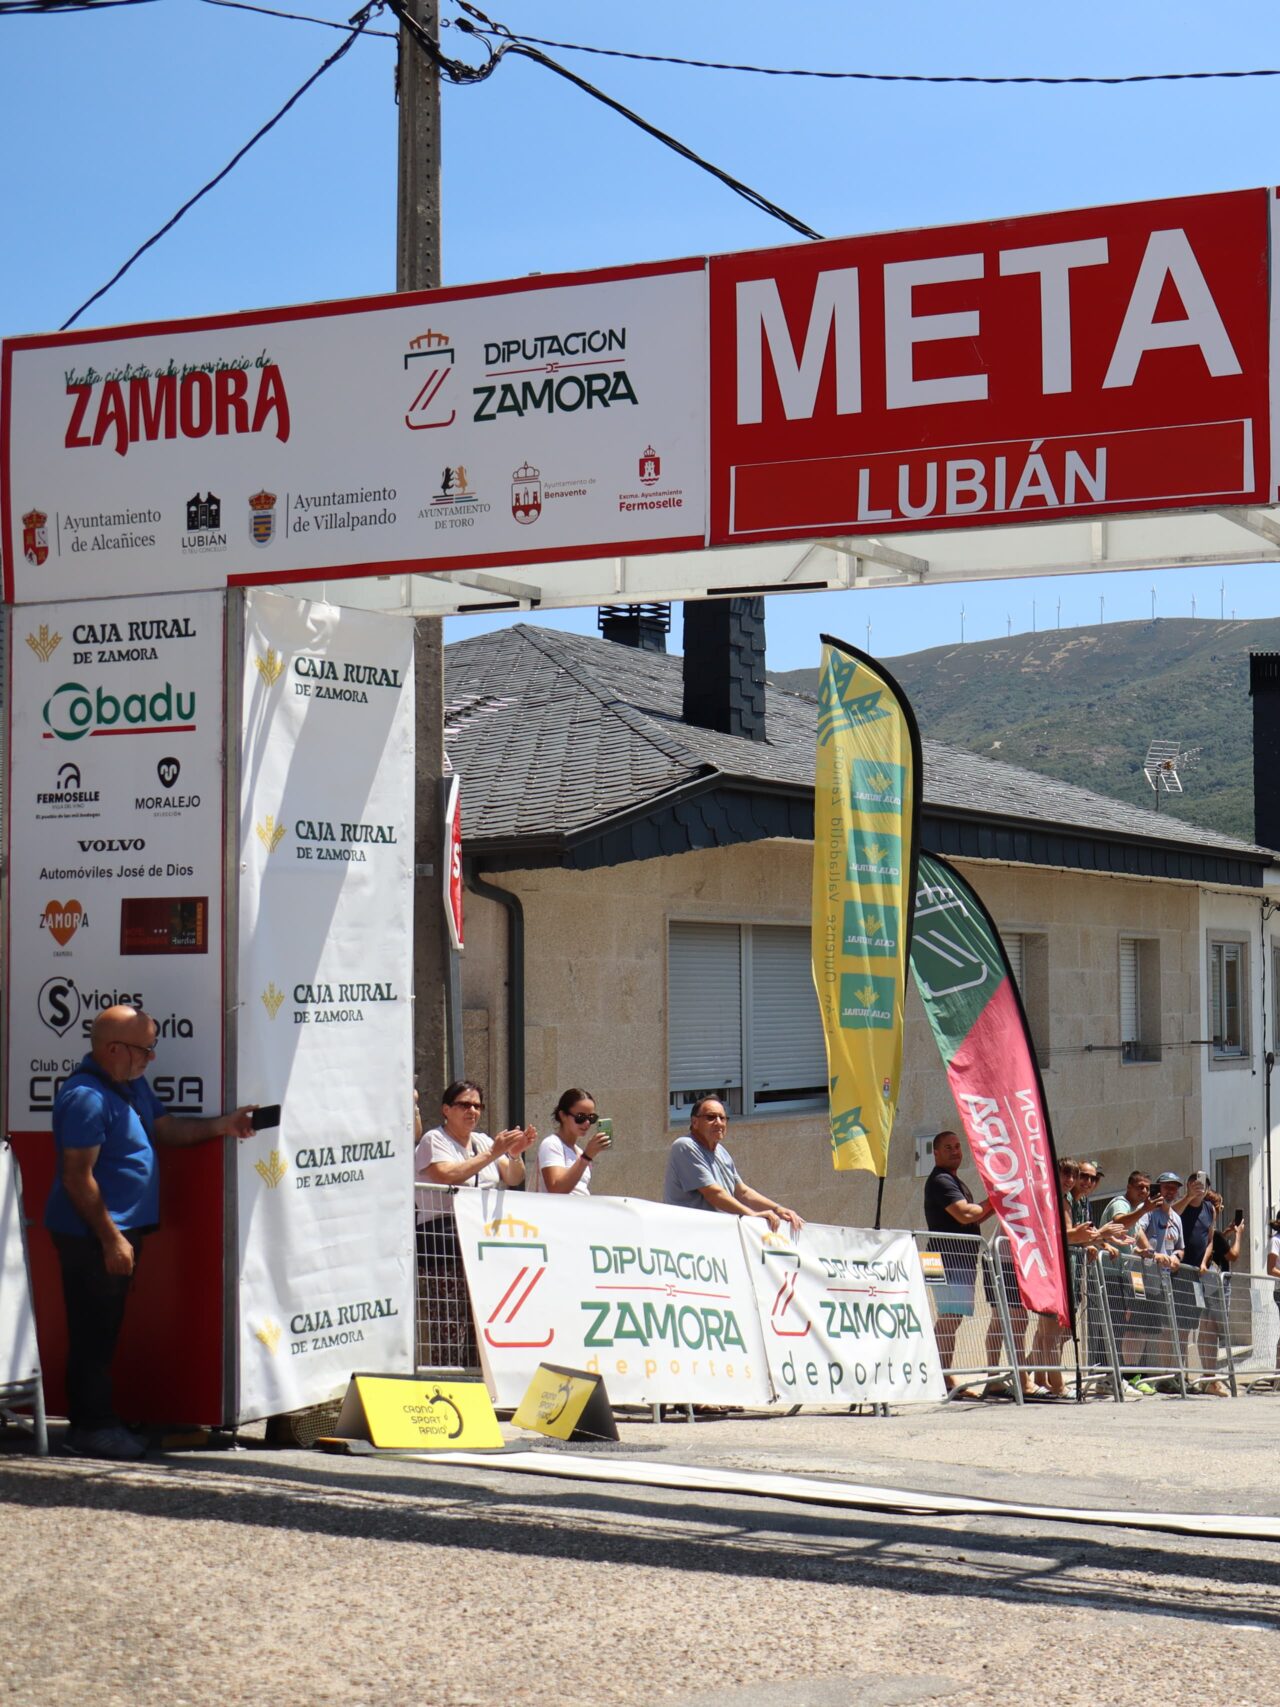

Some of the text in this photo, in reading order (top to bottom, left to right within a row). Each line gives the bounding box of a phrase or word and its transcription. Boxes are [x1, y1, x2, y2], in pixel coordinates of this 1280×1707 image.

[736, 228, 1243, 425] META
[473, 370, 639, 423] ZAMORA
[64, 364, 290, 457] ZAMORA
[857, 440, 1107, 521] LUBIÁN
[294, 486, 397, 510] Ayuntamiento
[544, 488, 587, 499] Benavente
[619, 497, 683, 512] Fermoselle
[64, 509, 162, 532] Ayuntamiento
[293, 509, 397, 533] de Villalpando
[418, 503, 491, 519] AYUNTAMIENTO
[434, 517, 475, 530] DE TORO
[71, 533, 156, 553] de Alcañices
[181, 532, 227, 548] LUBIÁN
[73, 617, 197, 645] CAJA RURAL
[73, 647, 159, 665] DE ZAMORA
[295, 656, 403, 689] CAJA RURAL
[295, 683, 369, 704] DE ZAMORA
[42, 681, 196, 741] Cobadu
[37, 791, 100, 804] FERMOSELLE
[135, 794, 201, 810] MORALEJO
[295, 820, 397, 845] CAJA RURAL
[78, 838, 146, 852] VOLVO
[296, 847, 367, 862] DE ZAMORA
[39, 863, 194, 881] Automóviles José de Dios
[39, 912, 90, 930] ZAMORA
[293, 982, 397, 1004] CAJA RURAL
[294, 1008, 364, 1024] DE ZAMORA
[30, 1058, 59, 1072] Club
[295, 1140, 395, 1169] CAJA RURAL
[296, 1170, 365, 1189] DE ZAMORA
[290, 1297, 398, 1335] CAJA RURAL
[819, 1300, 923, 1340] ZAMORA
[581, 1301, 748, 1354] ZAMORA
[291, 1329, 364, 1355] DE ZAMORA
[586, 1354, 752, 1380] deportes
[782, 1351, 928, 1394] deportes
